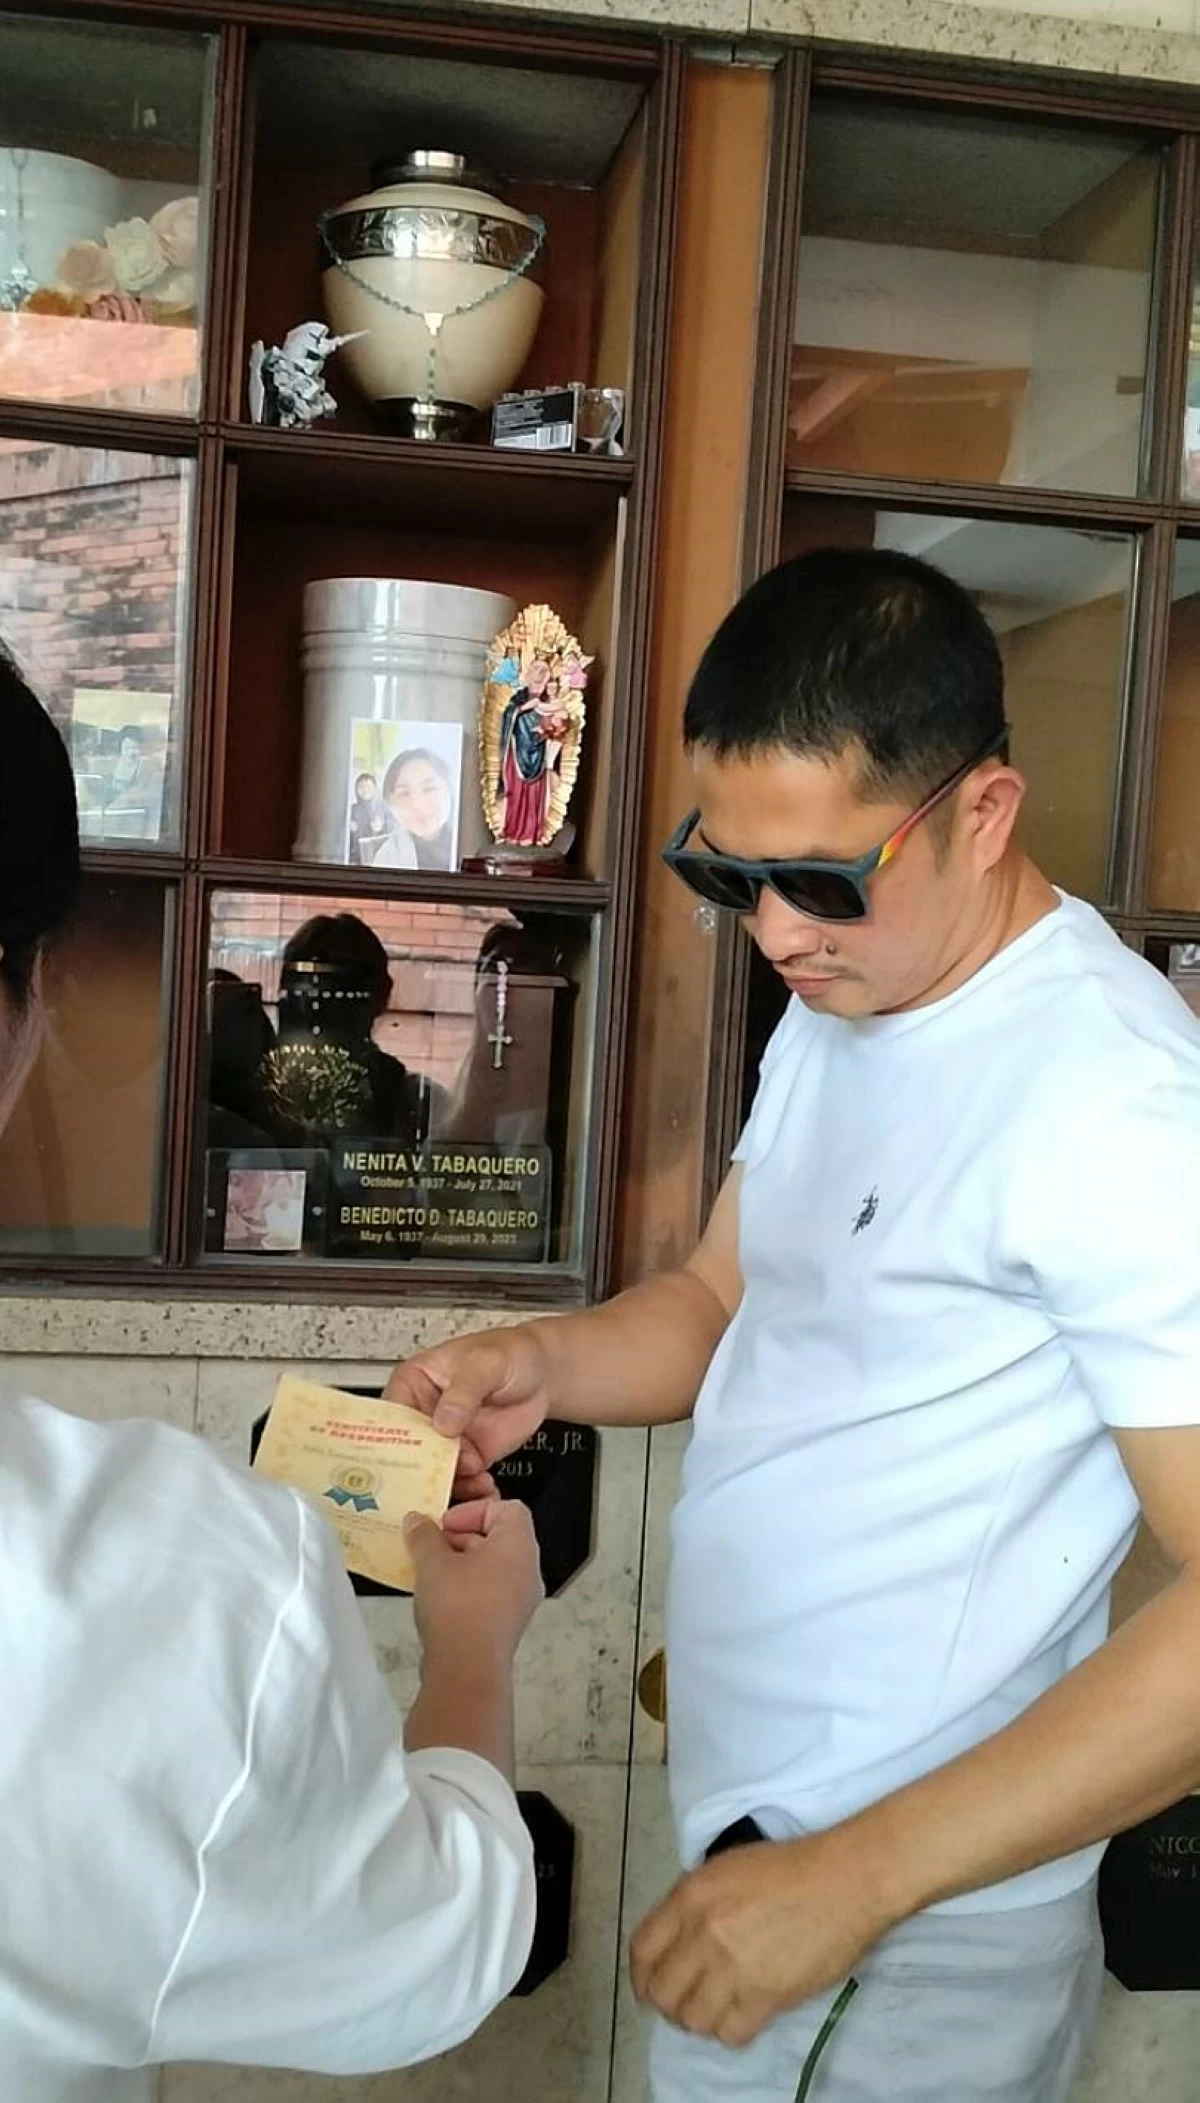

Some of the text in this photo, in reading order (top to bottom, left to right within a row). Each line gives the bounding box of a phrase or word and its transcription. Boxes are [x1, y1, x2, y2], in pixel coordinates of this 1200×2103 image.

[343, 1152, 407, 1171] NENITA
[431, 1154, 540, 1176] TABAQUERO
[361, 1175, 406, 1189] October
[420, 1177, 445, 1189] 1937
[454, 1179, 477, 1192] July
[497, 1180, 523, 1191] 2021
[340, 1206, 426, 1226] BENEDICTO
[447, 1209, 538, 1229] TABAQUERO
[360, 1229, 383, 1244] May
[398, 1231, 424, 1242] 1937
[432, 1231, 471, 1246] August
